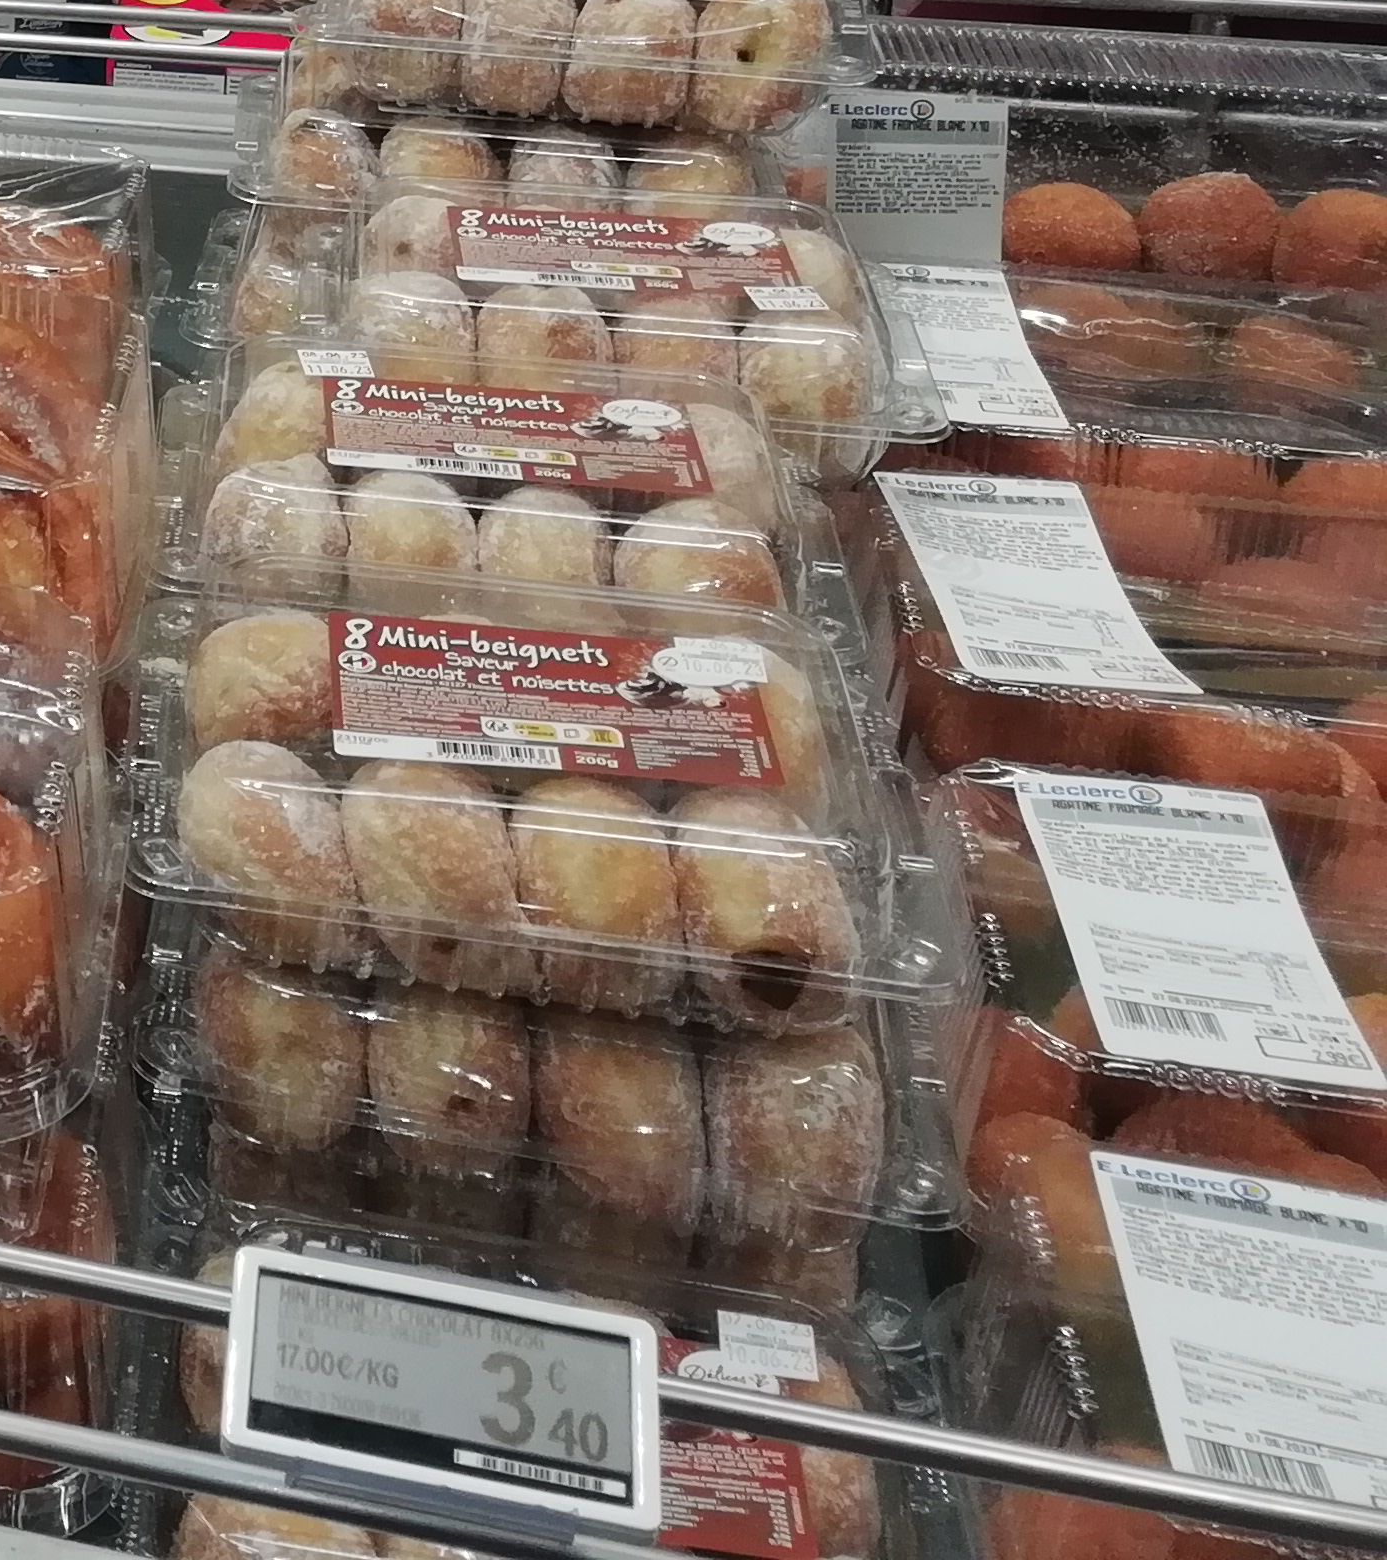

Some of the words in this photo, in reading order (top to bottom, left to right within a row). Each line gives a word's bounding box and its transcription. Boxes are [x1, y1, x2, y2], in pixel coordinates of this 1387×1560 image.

[851, 119, 888, 131] AGATINE
[892, 119, 932, 132] FROMAGE
[937, 120, 966, 132] BLANC
[461, 210, 484, 226] 8
[487, 212, 669, 236] Mini-beignets
[491, 231, 560, 245] chocolat
[567, 235, 585, 246] et
[593, 237, 675, 251] noisettes
[306, 364, 372, 376] 11.06.23
[335, 379, 362, 400] 8
[364, 383, 565, 415] Mini-beignets
[424, 401, 488, 416] Saveur
[368, 406, 442, 425] chocolat
[450, 413, 472, 426] et
[480, 416, 569, 432] noisettes
[534, 469, 571, 480] 200g
[344, 618, 374, 650] 8
[378, 625, 610, 670] Mini-beignets
[445, 651, 519, 672] Saveur
[683, 659, 765, 677] 10.06.23
[381, 661, 467, 683] chocolat
[478, 669, 503, 686] et
[512, 675, 614, 696] noisettes
[575, 754, 619, 770] 200g
[1052, 799, 1102, 813] AGATINE
[1109, 803, 1165, 817] FROMAGE
[1171, 808, 1212, 820] BLANC
[1136, 1181, 1198, 1204] AGATINE
[1204, 1193, 1272, 1217] FROMAGE
[1280, 1207, 1328, 1225] BLANC
[276, 1342, 400, 1390] 17.00€/KG
[547, 1358, 569, 1395] €
[479, 1351, 536, 1447] 3
[548, 1408, 609, 1463] 40
